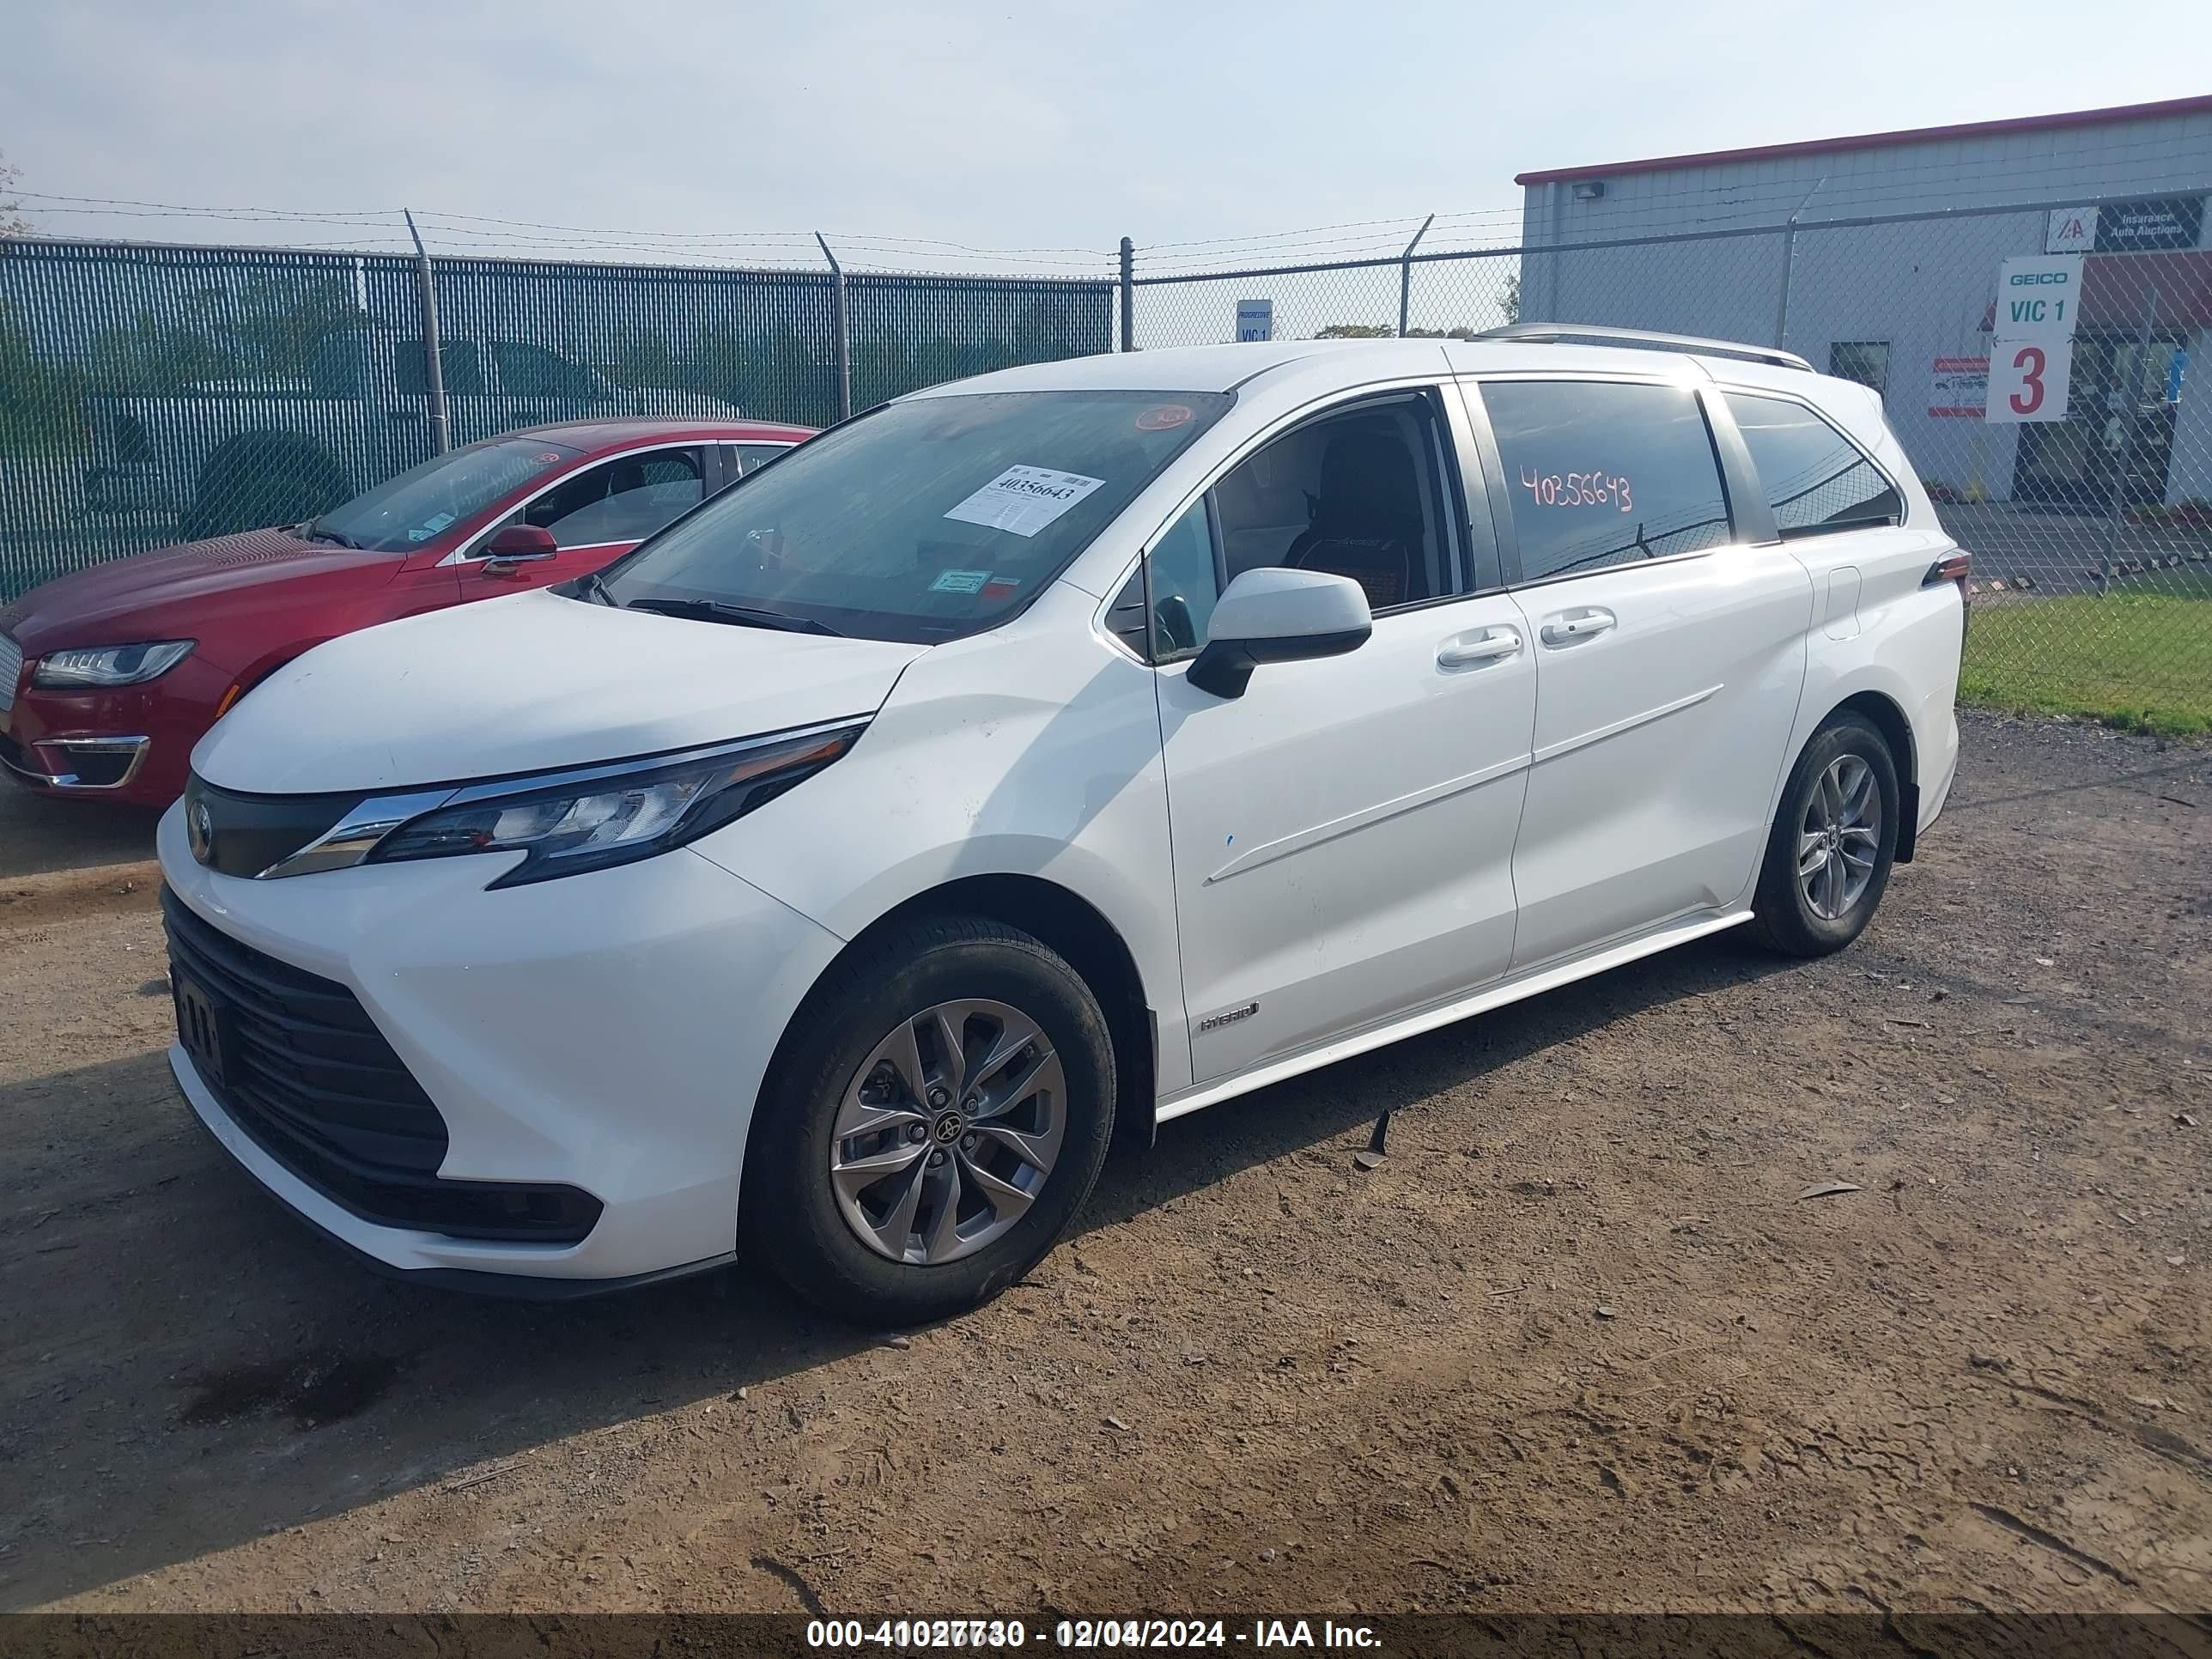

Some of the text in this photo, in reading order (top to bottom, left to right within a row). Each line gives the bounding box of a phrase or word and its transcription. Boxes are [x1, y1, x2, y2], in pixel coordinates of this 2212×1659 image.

[2123, 213, 2175, 225] Insurance
[2111, 224, 2183, 238] Auto Auctions
[2009, 272, 2069, 286] GEICO
[2010, 300, 2064, 323] VIC 1
[1242, 329, 1266, 342] VIC 1
[2009, 347, 2046, 415] 3
[998, 477, 1075, 500] 40356643
[1519, 464, 1632, 512] 40356643
[1201, 1003, 1255, 1031] HYBRID
